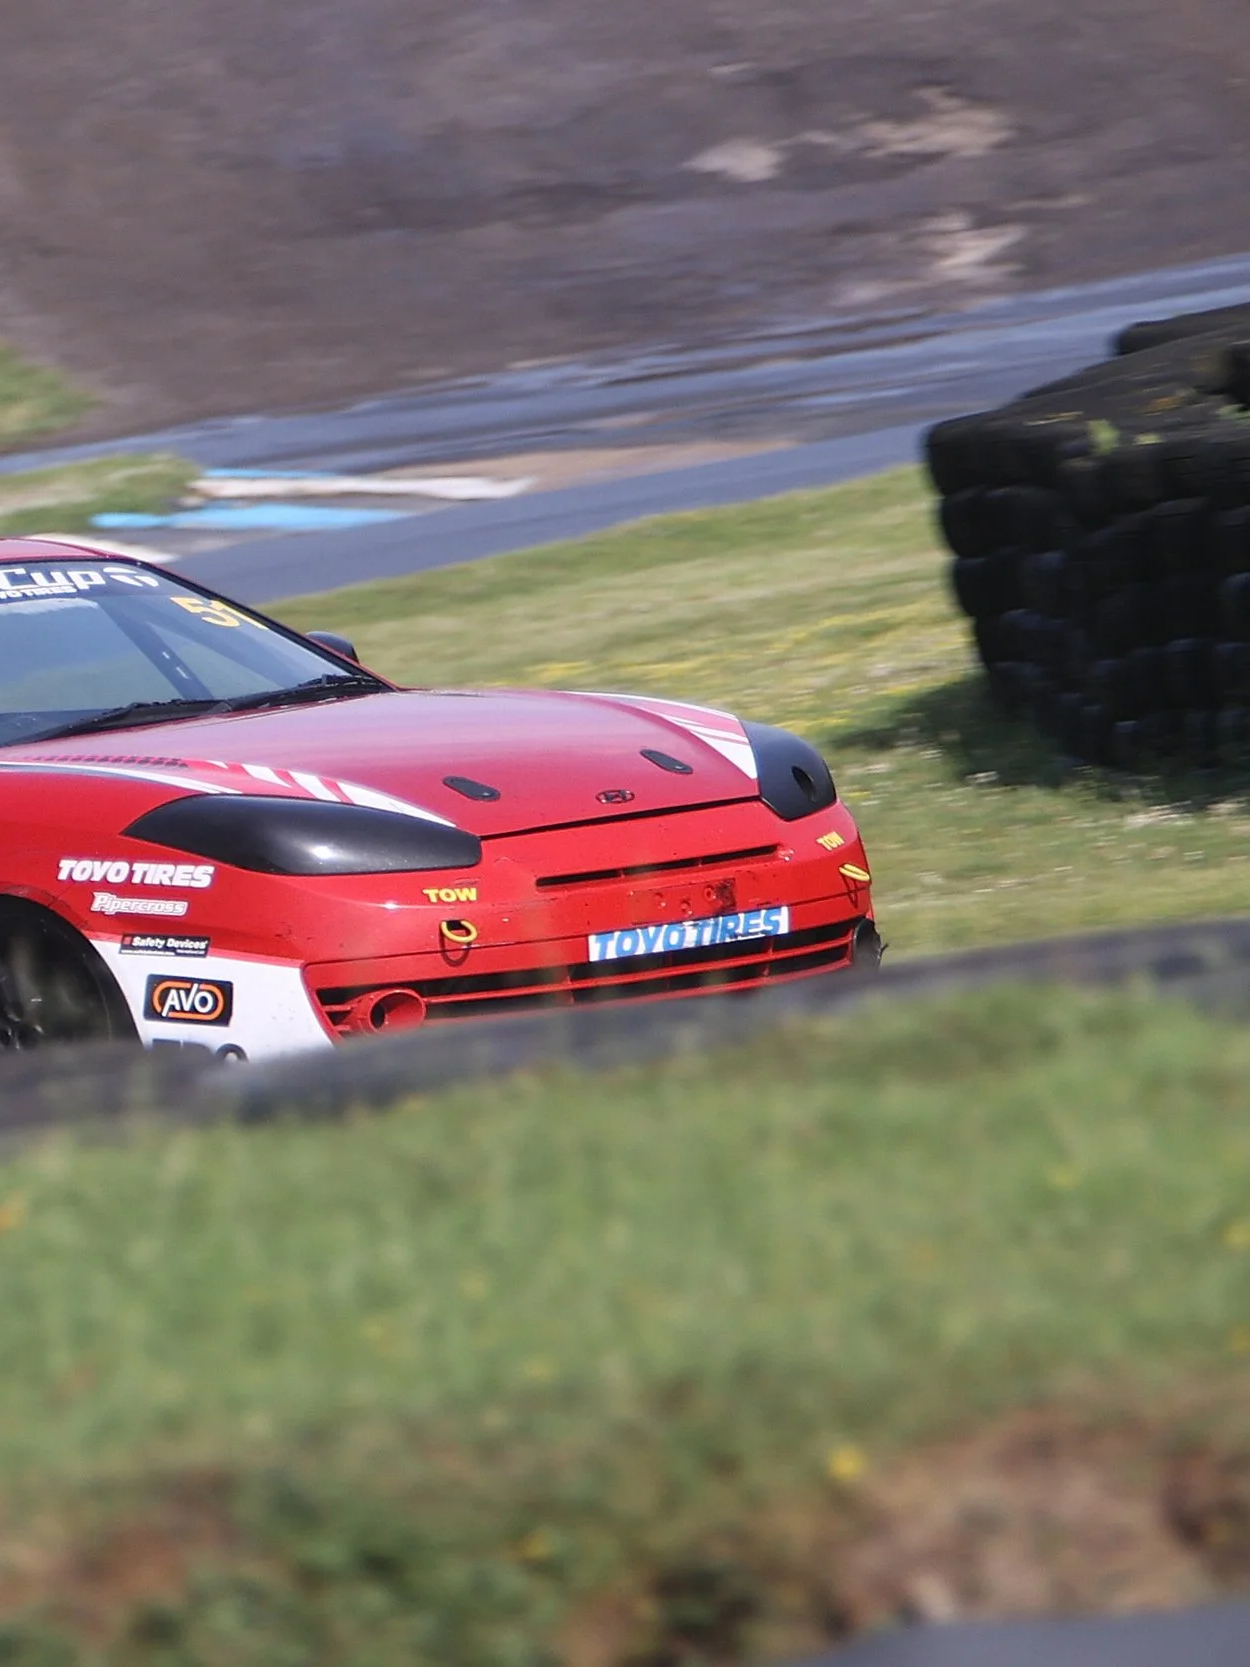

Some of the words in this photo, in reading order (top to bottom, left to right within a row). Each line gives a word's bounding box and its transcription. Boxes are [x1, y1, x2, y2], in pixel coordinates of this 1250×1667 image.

[19, 584, 77, 597] TIRES
[170, 596, 268, 631] 51
[57, 859, 130, 884] TOYO
[130, 863, 215, 888] TIRES
[91, 891, 188, 916] Pipercross
[422, 887, 477, 904] TOW
[132, 936, 165, 949] Safety
[593, 924, 686, 961] TOYO
[686, 907, 783, 949] TIRES
[161, 983, 214, 1017] AVO
